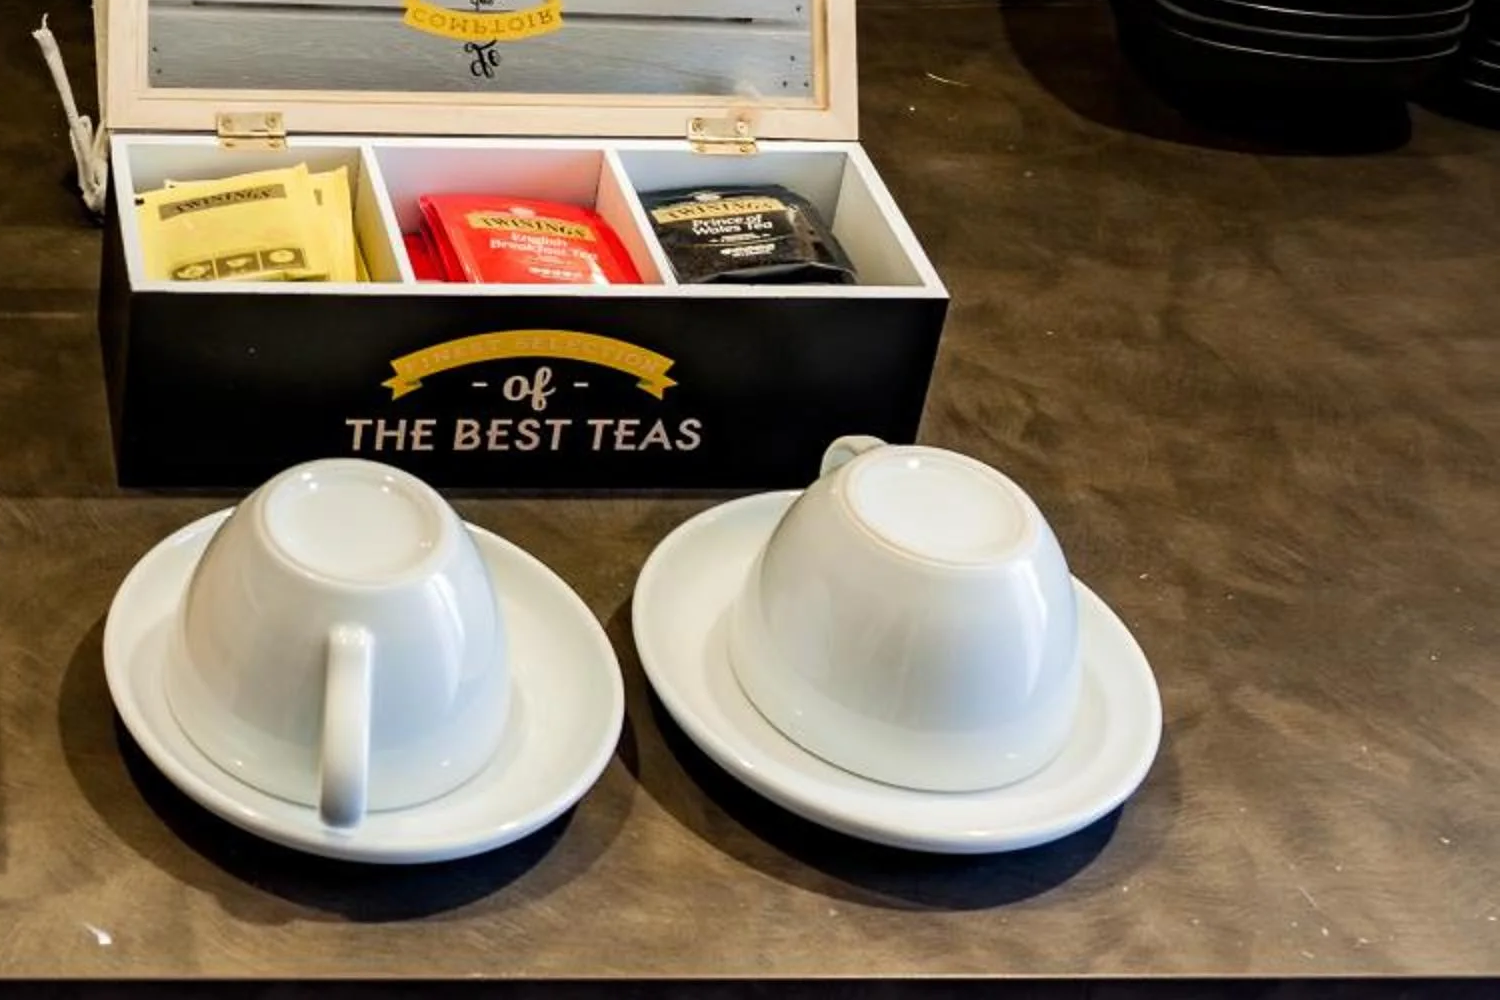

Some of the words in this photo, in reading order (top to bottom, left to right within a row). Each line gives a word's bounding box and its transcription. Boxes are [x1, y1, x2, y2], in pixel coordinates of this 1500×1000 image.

[667, 199, 774, 219] TWININGS
[692, 216, 743, 230] Prince
[745, 214, 763, 225] of
[692, 224, 743, 236] Wales
[747, 220, 774, 231] Tea
[402, 339, 502, 374] FINEST
[515, 337, 659, 373] SELECTION
[503, 365, 557, 411] of
[345, 418, 437, 451] THE
[452, 418, 573, 451] BEST
[586, 418, 703, 451] TEAS
